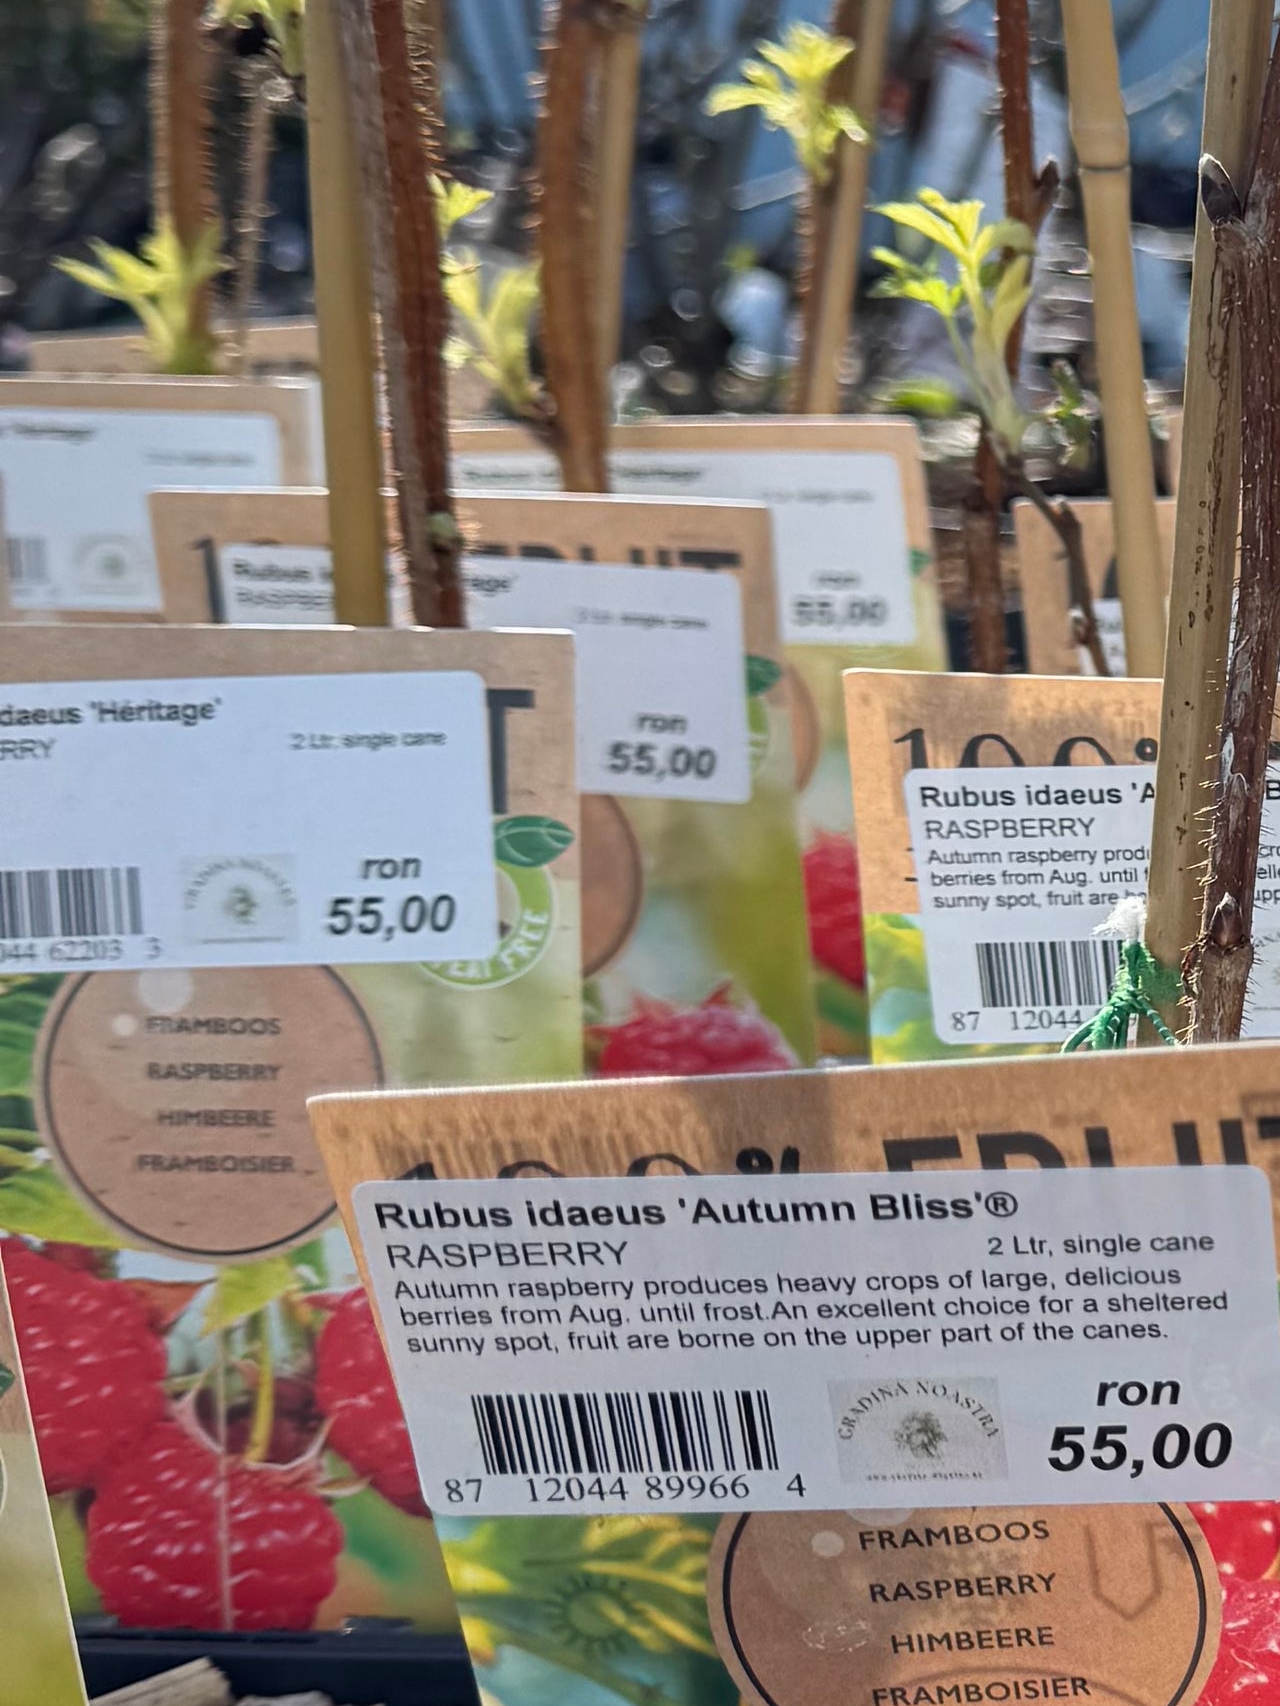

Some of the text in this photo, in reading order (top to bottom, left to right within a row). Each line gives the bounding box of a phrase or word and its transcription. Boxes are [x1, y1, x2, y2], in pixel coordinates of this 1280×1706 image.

[0, 705, 82, 727] daeus
[607, 741, 717, 782] 55,00
[920, 786, 1016, 807] Rubus
[1025, 785, 1122, 805] idaeus
[925, 818, 1094, 839] RASPBERRY
[362, 858, 421, 879] ron
[328, 895, 455, 941] 55,00
[375, 1202, 512, 1229] Rubus
[526, 1200, 665, 1226] idaeus
[387, 1241, 627, 1269] RASPBERRY
[988, 1234, 1214, 1257] 2 Ltr, single cane
[1097, 1381, 1180, 1406] ron
[1048, 1423, 1232, 1478] 55,00
[445, 1474, 806, 1502] 87 12044 89966 4
[859, 1520, 1049, 1551] FRAMBOOS
[870, 1573, 1055, 1602] RASPBERRY
[891, 1627, 1054, 1654] HIMBEERE
[873, 1677, 1090, 1706] FRAMBOISIER
